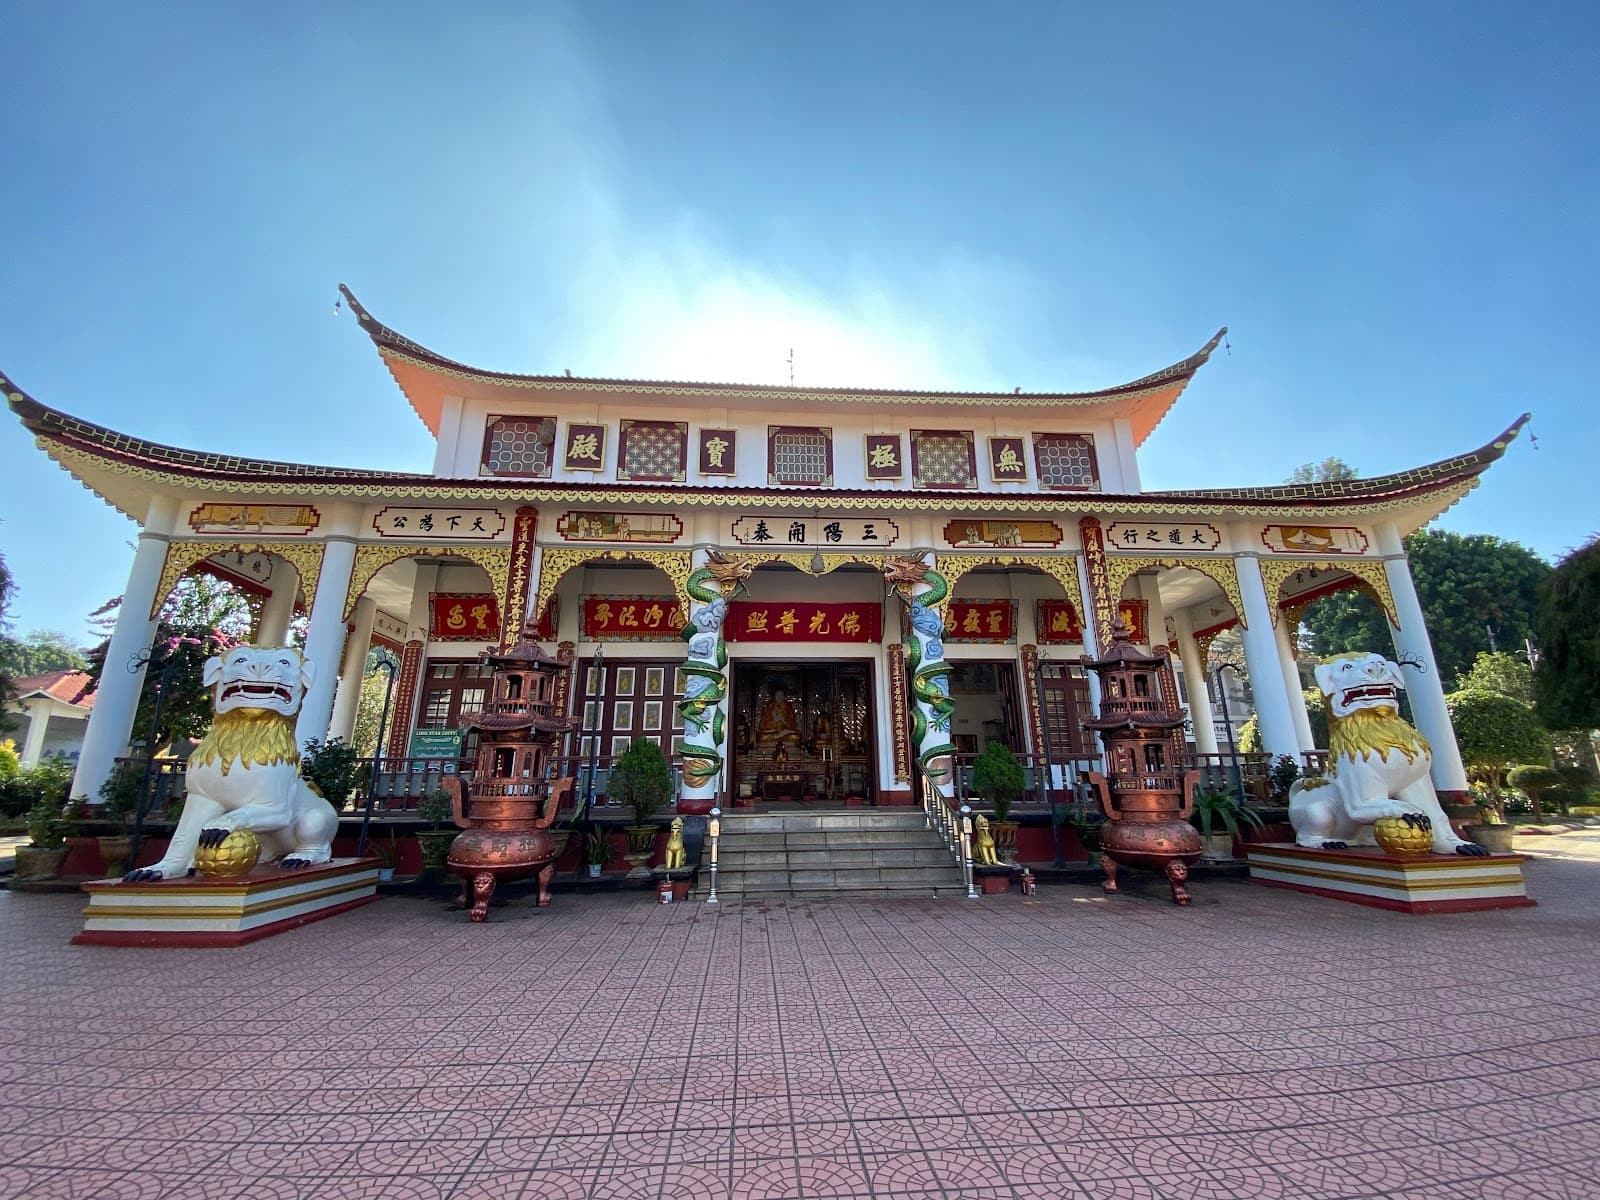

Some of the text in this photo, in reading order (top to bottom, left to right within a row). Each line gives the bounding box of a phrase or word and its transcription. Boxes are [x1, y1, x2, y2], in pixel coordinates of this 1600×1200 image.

[567, 432, 1024, 473] 無 極 寶 殿
[751, 519, 878, 543] 三陽開泰
[1123, 528, 1207, 545] 大道之行
[745, 608, 861, 637] 佛光普照
